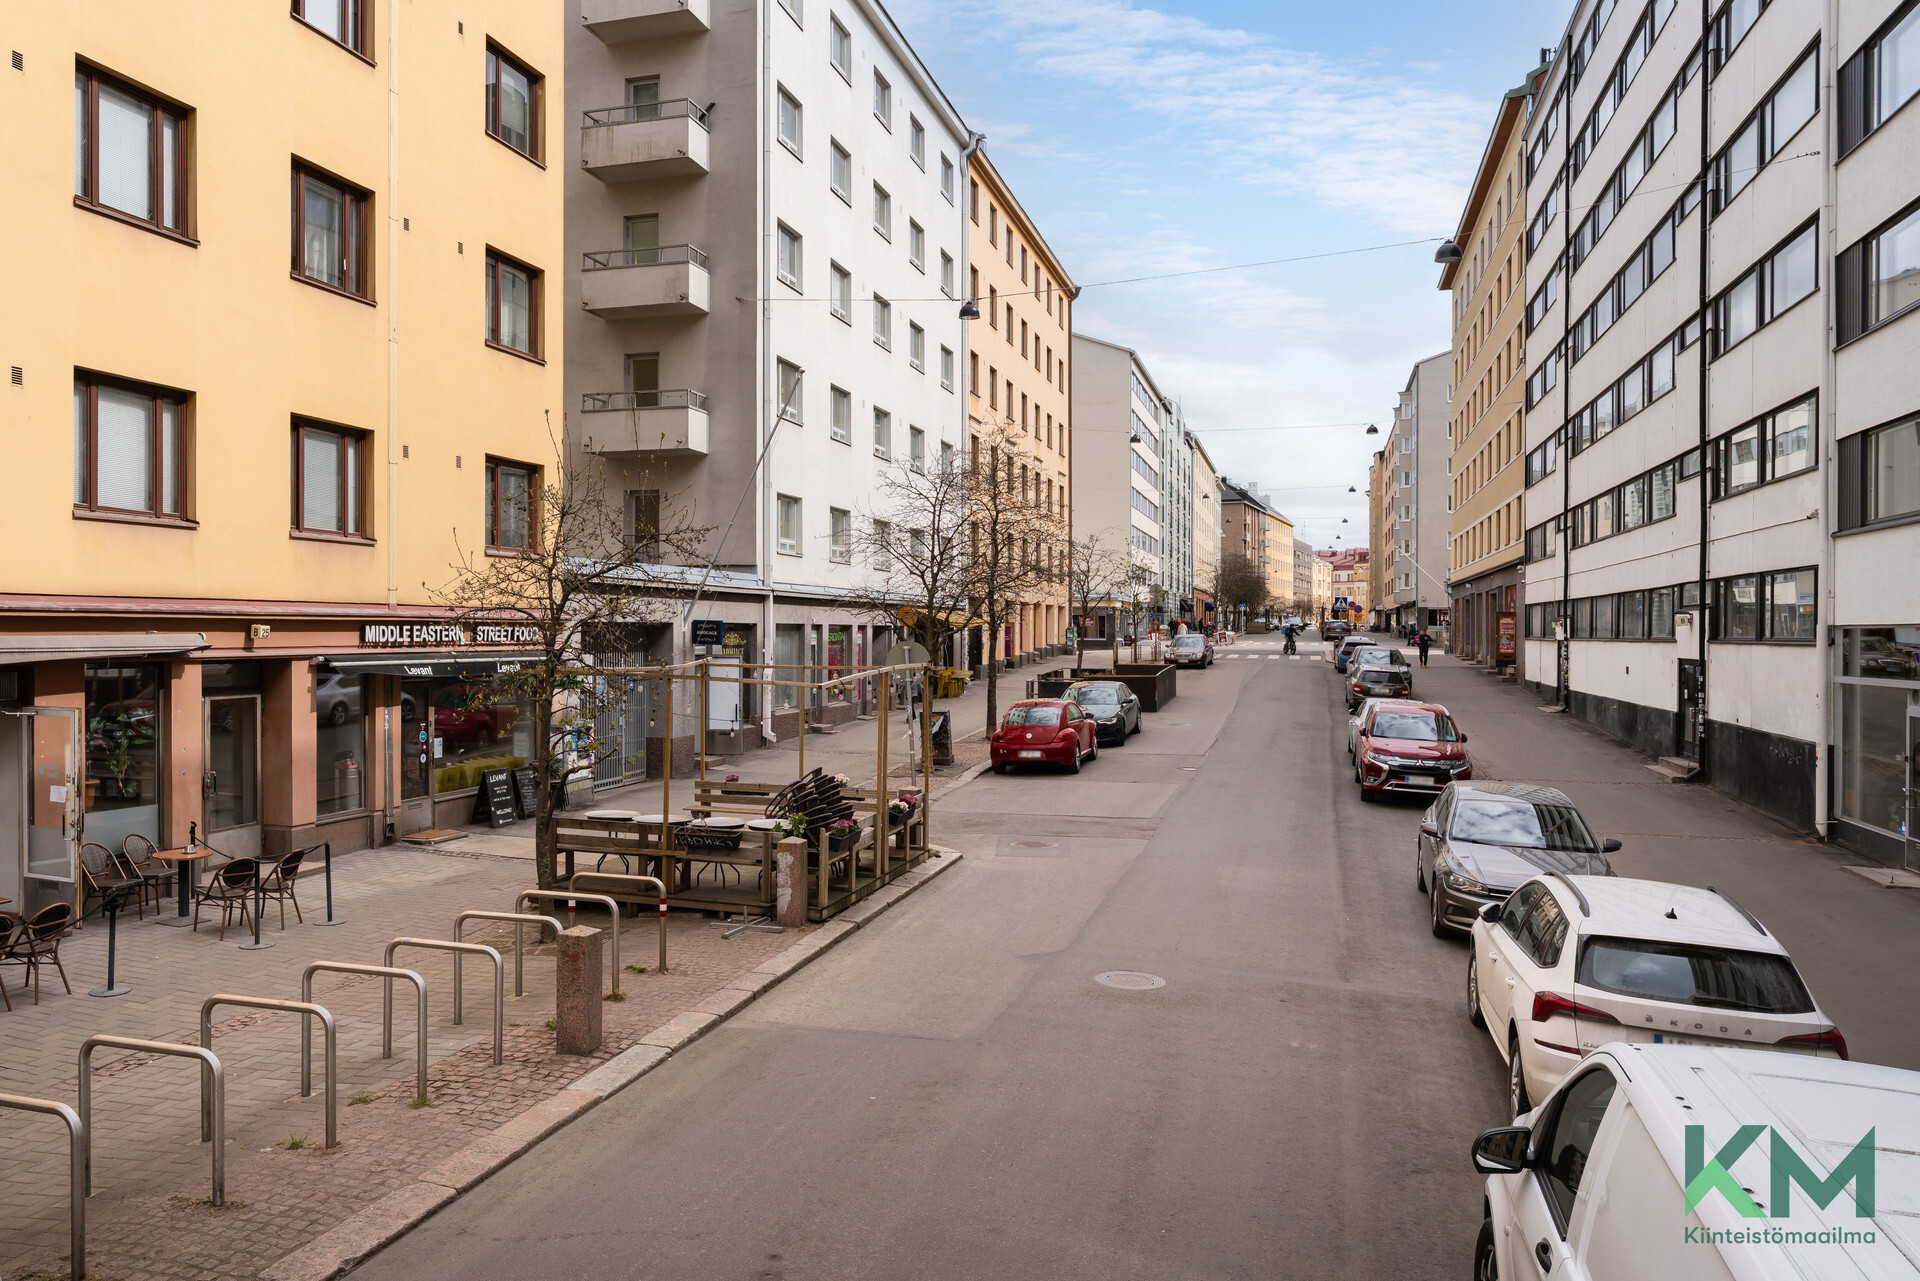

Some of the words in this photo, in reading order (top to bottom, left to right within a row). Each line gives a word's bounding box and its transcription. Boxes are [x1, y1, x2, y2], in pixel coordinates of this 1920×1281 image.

[253, 627, 259, 637] B
[261, 628, 270, 638] 25
[365, 625, 411, 643] MIDDLE
[413, 625, 464, 643] EASTERN
[476, 625, 513, 641] STREET
[404, 665, 433, 676] Levant
